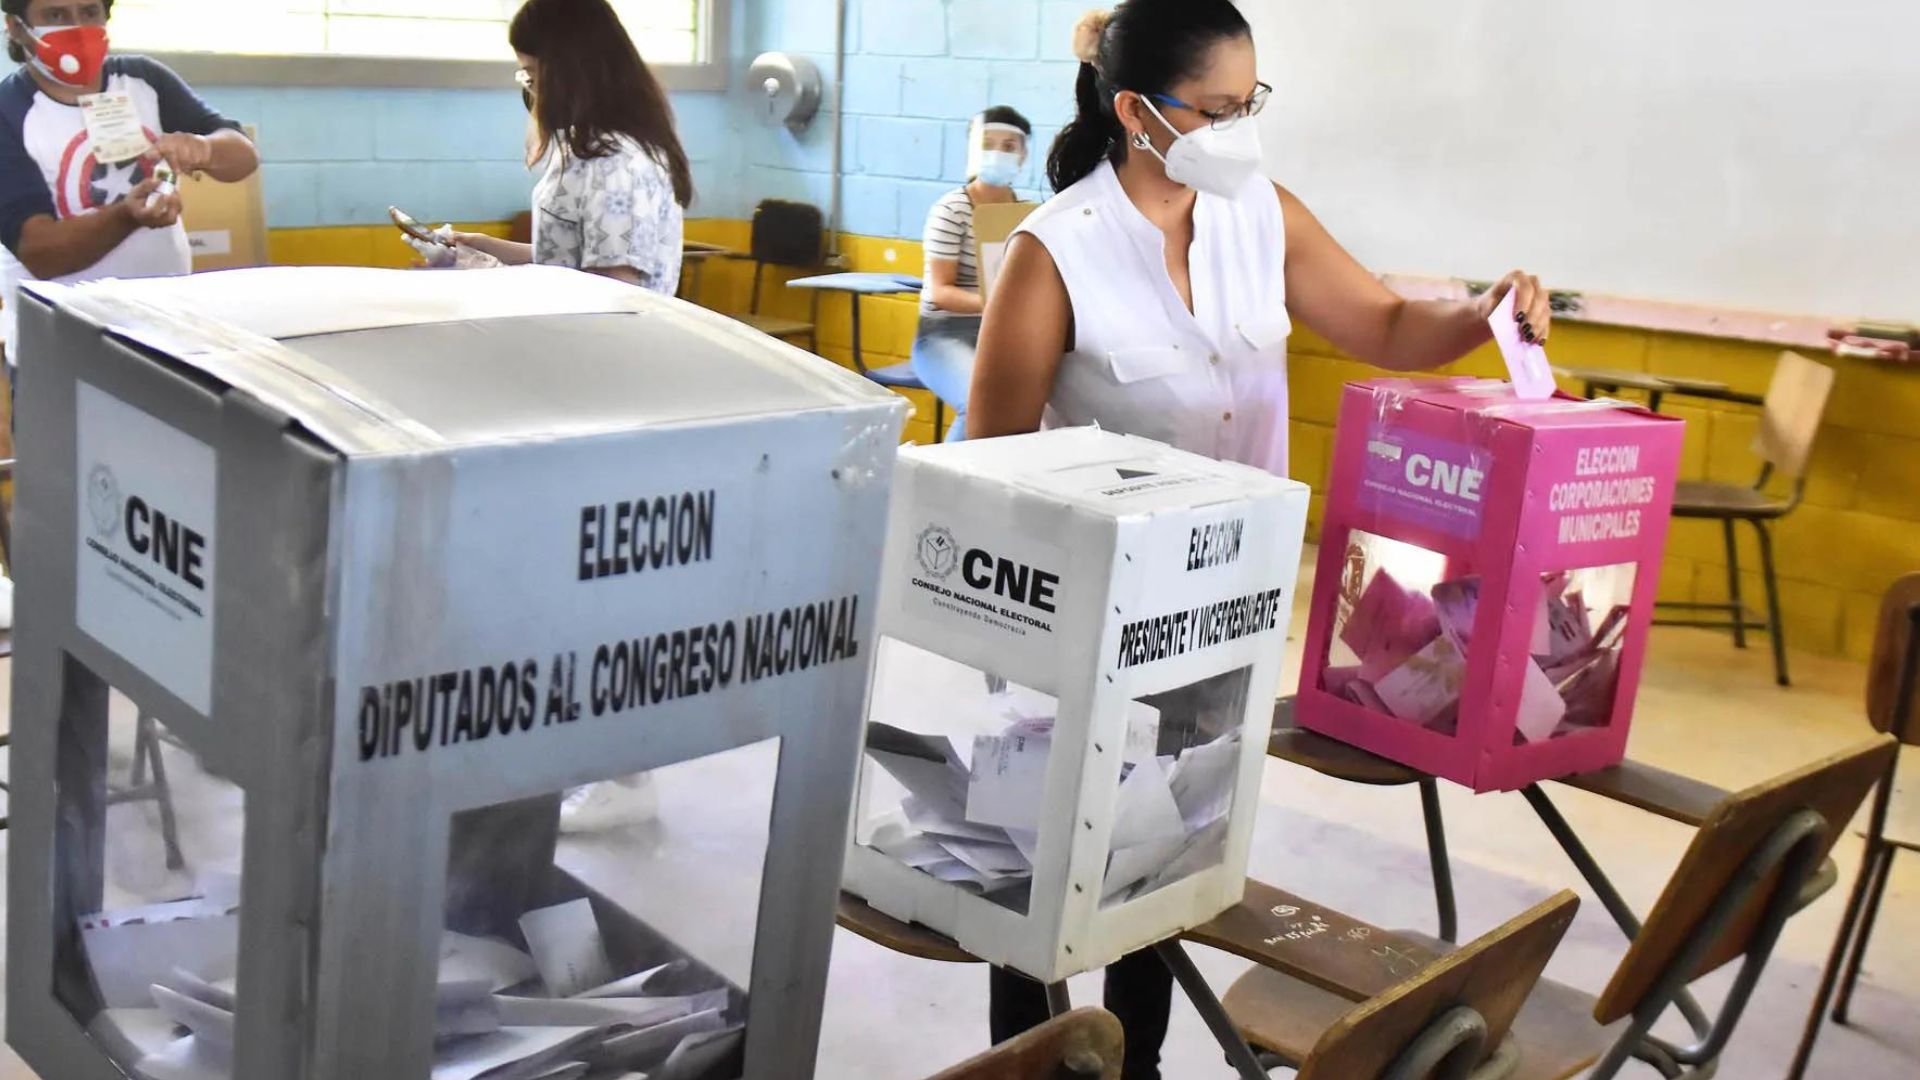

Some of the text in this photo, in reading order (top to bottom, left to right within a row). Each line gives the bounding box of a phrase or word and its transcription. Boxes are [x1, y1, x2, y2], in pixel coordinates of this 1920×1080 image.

[1405, 453, 1484, 502] CNE
[1575, 445, 1640, 476] ELECCION
[1549, 476, 1656, 512] CORPORACIONES
[125, 495, 205, 590] CNE
[578, 489, 715, 581] ELECCION
[1186, 519, 1243, 571] ELECCION
[1558, 509, 1641, 544] MUNICIPALES
[120, 558, 157, 588] NACIONAL
[158, 582, 203, 617] ELECTORAL
[912, 578, 1052, 632] CONSEJO NACIONAL ELECTORAL
[962, 548, 1060, 613] CNE
[933, 597, 1026, 635] Construyendo Democracia
[1118, 588, 1281, 669] PRESIDENTE Y VICEPRESIDENTE
[544, 651, 581, 727] AL
[590, 618, 737, 717] CONGRESO
[740, 594, 858, 685] NACIONAL
